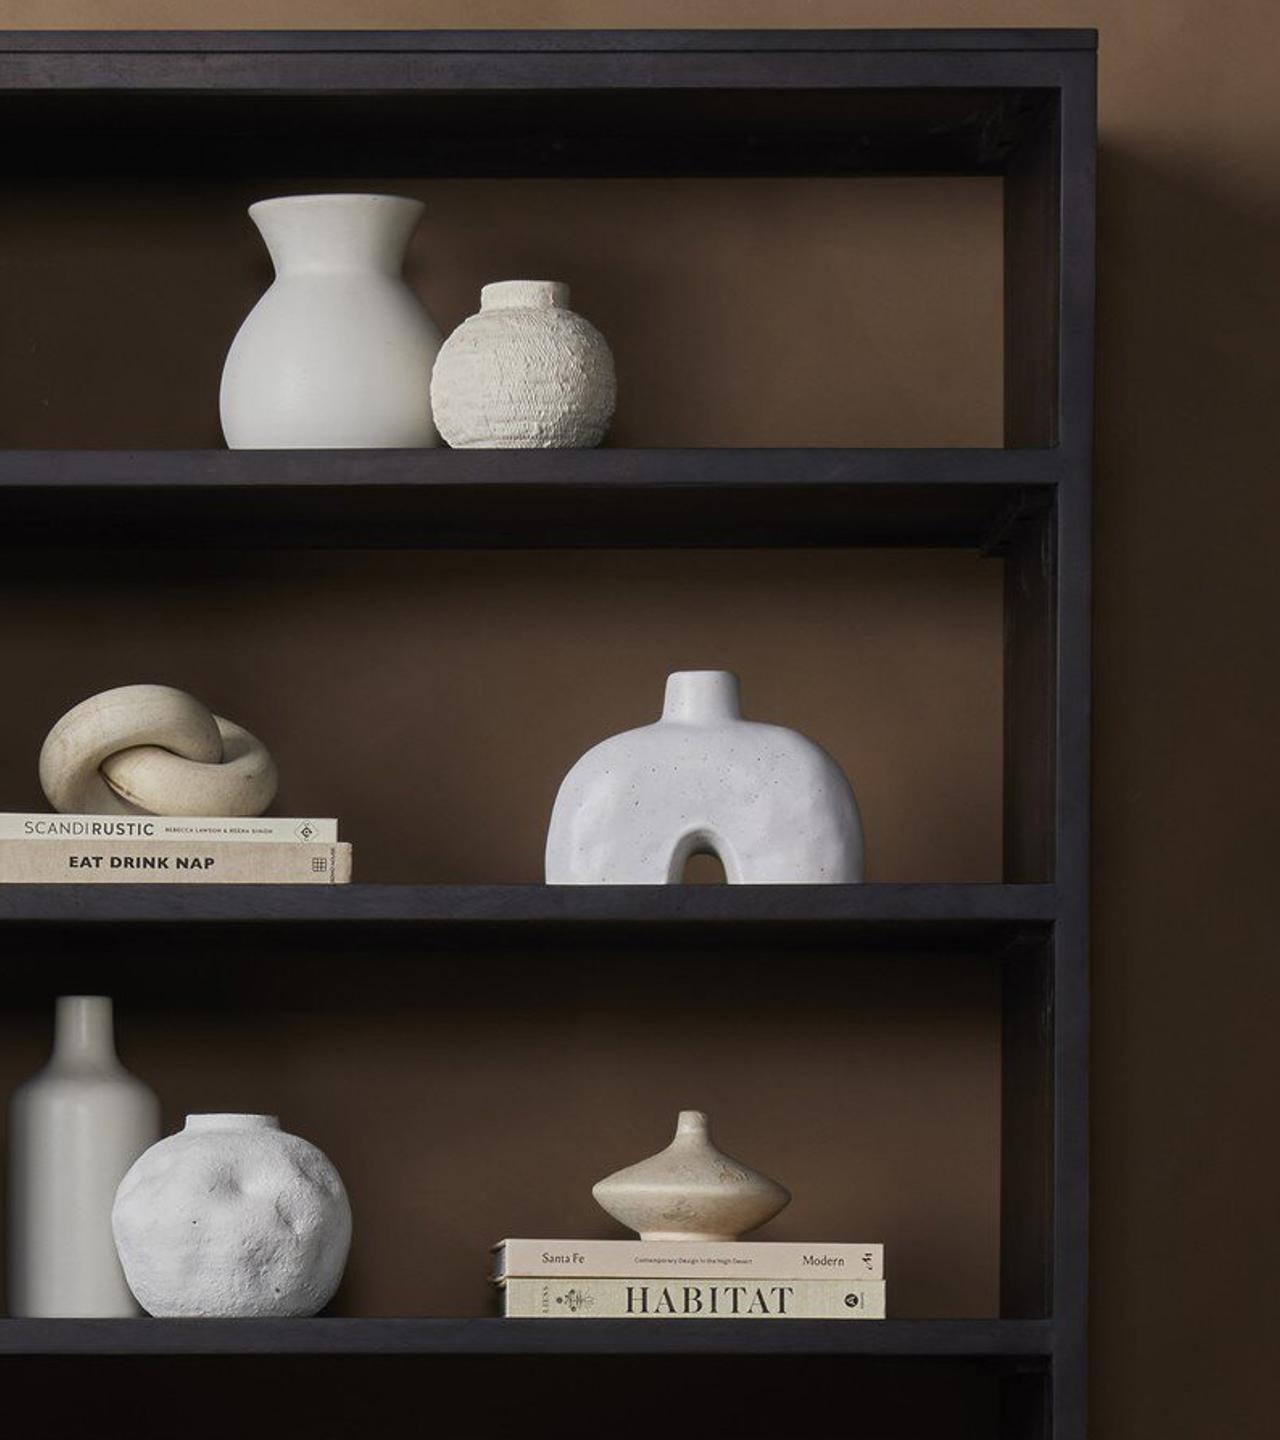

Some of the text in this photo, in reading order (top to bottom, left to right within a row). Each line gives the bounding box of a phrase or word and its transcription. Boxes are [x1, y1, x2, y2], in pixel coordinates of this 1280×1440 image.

[24, 821, 155, 836] SCANDIRUSTIC
[68, 856, 215, 869] EAT DRINK NAP
[542, 1252, 585, 1264] Santa Fe
[802, 1255, 845, 1266] Modern
[626, 1287, 795, 1314] HABITAT
